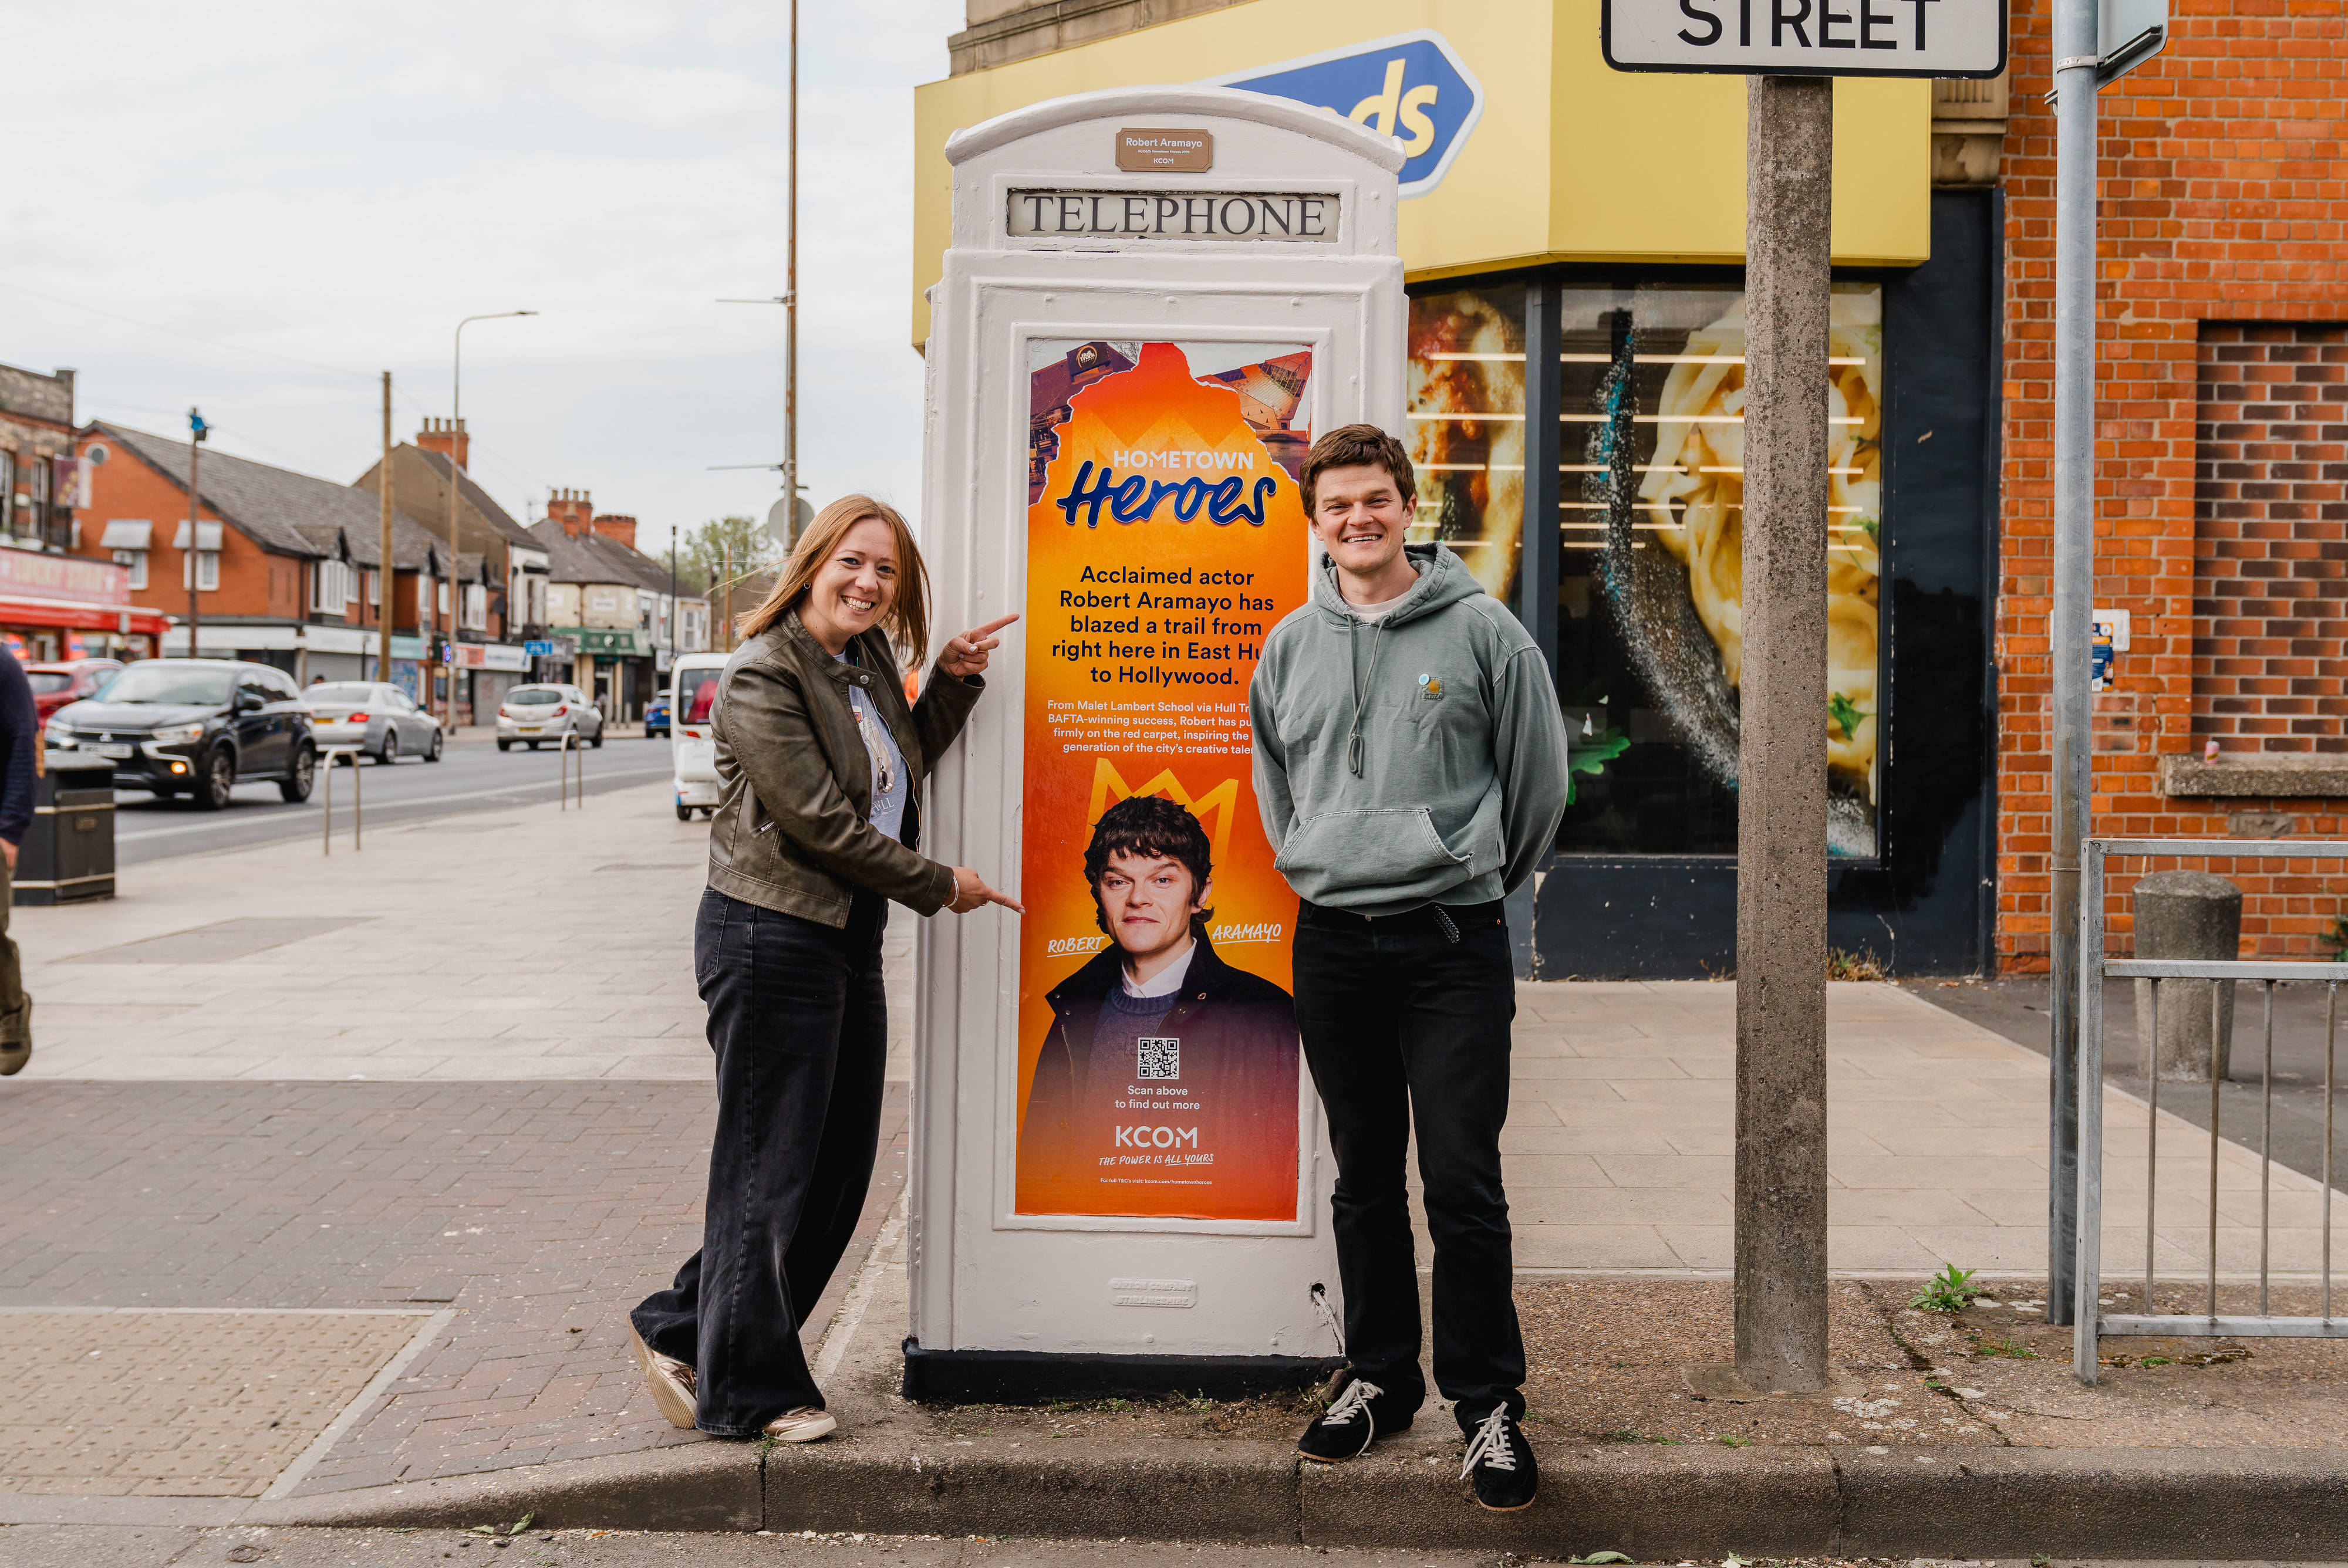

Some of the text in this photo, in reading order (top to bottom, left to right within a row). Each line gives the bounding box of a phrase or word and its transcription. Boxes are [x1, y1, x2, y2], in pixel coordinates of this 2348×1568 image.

[1677, 0, 1938, 50] STREET
[1319, 58, 1438, 158] ds
[1126, 138, 1202, 148] Robert Aramayo
[1024, 196, 1326, 235] TELEPHONE
[1114, 450, 1254, 469] HOMETOWN
[1056, 460, 1277, 528] Heroes
[1080, 566, 1254, 585] Acclaimed actor
[1061, 590, 1273, 613] Robert Aramayo has
[1071, 615, 1261, 635] blazed a trail from
[1053, 640, 1101, 661] right
[1109, 641, 1155, 658] here
[1163, 641, 1179, 658] in
[1188, 643, 1230, 660] East
[1091, 666, 1239, 687] to Hollywood.
[1048, 700, 1249, 712] From Malet Lambert School via Hull Tr
[1048, 714, 1251, 728] BAFTA-winning success, Robert has pu
[1054, 728, 1084, 739] firmly
[1103, 728, 1120, 738] the
[1124, 729, 1140, 738] red
[1143, 731, 1180, 741] carpet,
[1184, 730, 1229, 742] inspiring
[1232, 731, 1249, 740] the
[1063, 742, 1119, 753] generation
[1123, 743, 1133, 752] of
[1136, 743, 1153, 752] the
[1186, 744, 1227, 753] creative
[1231, 745, 1253, 754] tale
[1047, 924, 1281, 953] ROBERT ARAMAYO
[1128, 1086, 1188, 1095] Scan above
[1115, 1100, 1126, 1108] to
[1129, 1099, 1149, 1109] find
[1115, 1126, 1197, 1148] KCOM
[1099, 1154, 1214, 1166] THE POWER IS ALL YOURS
